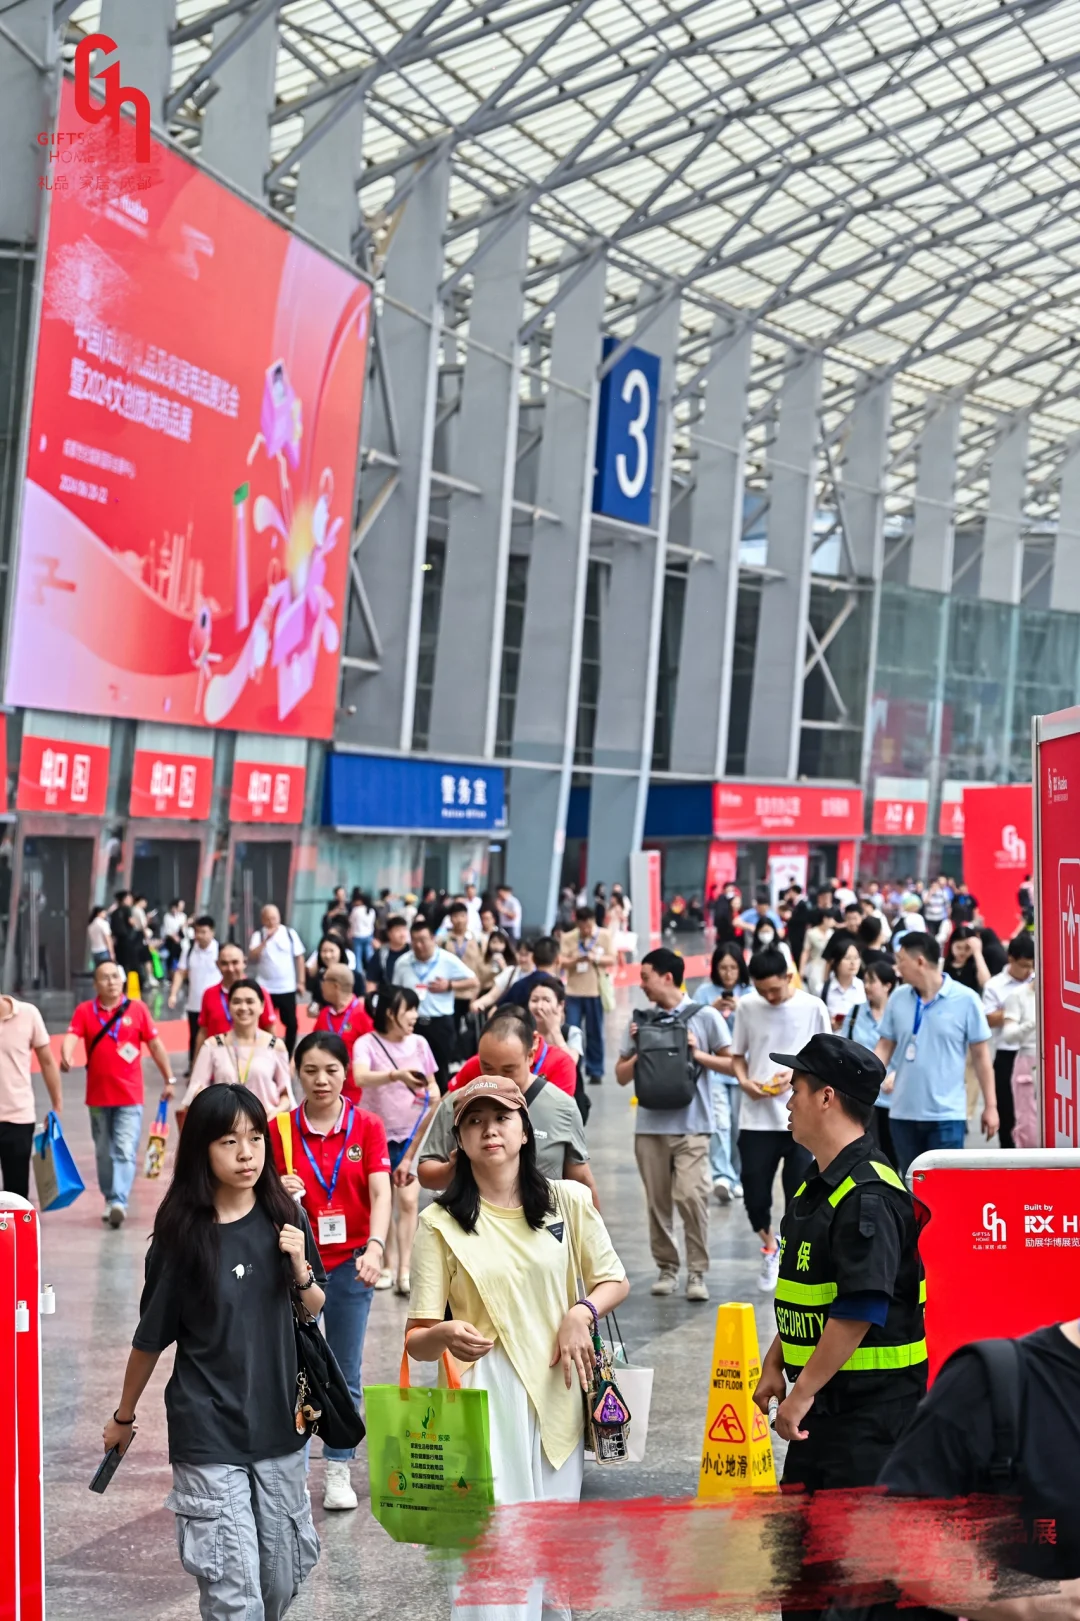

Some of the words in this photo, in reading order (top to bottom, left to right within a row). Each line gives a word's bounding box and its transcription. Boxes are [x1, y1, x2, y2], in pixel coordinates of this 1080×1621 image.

[615, 368, 650, 499] 3
[441, 774, 488, 806] 警务室
[1043, 1204, 1053, 1212] by
[1024, 1215, 1055, 1234] RX
[1062, 1215, 1080, 1233] H
[776, 1306, 825, 1338] SECURITY
[716, 1367, 741, 1379] CAUTION
[712, 1379, 725, 1389] WET
[725, 1380, 744, 1391] FLOOR
[702, 1451, 748, 1478] 小心地滑
